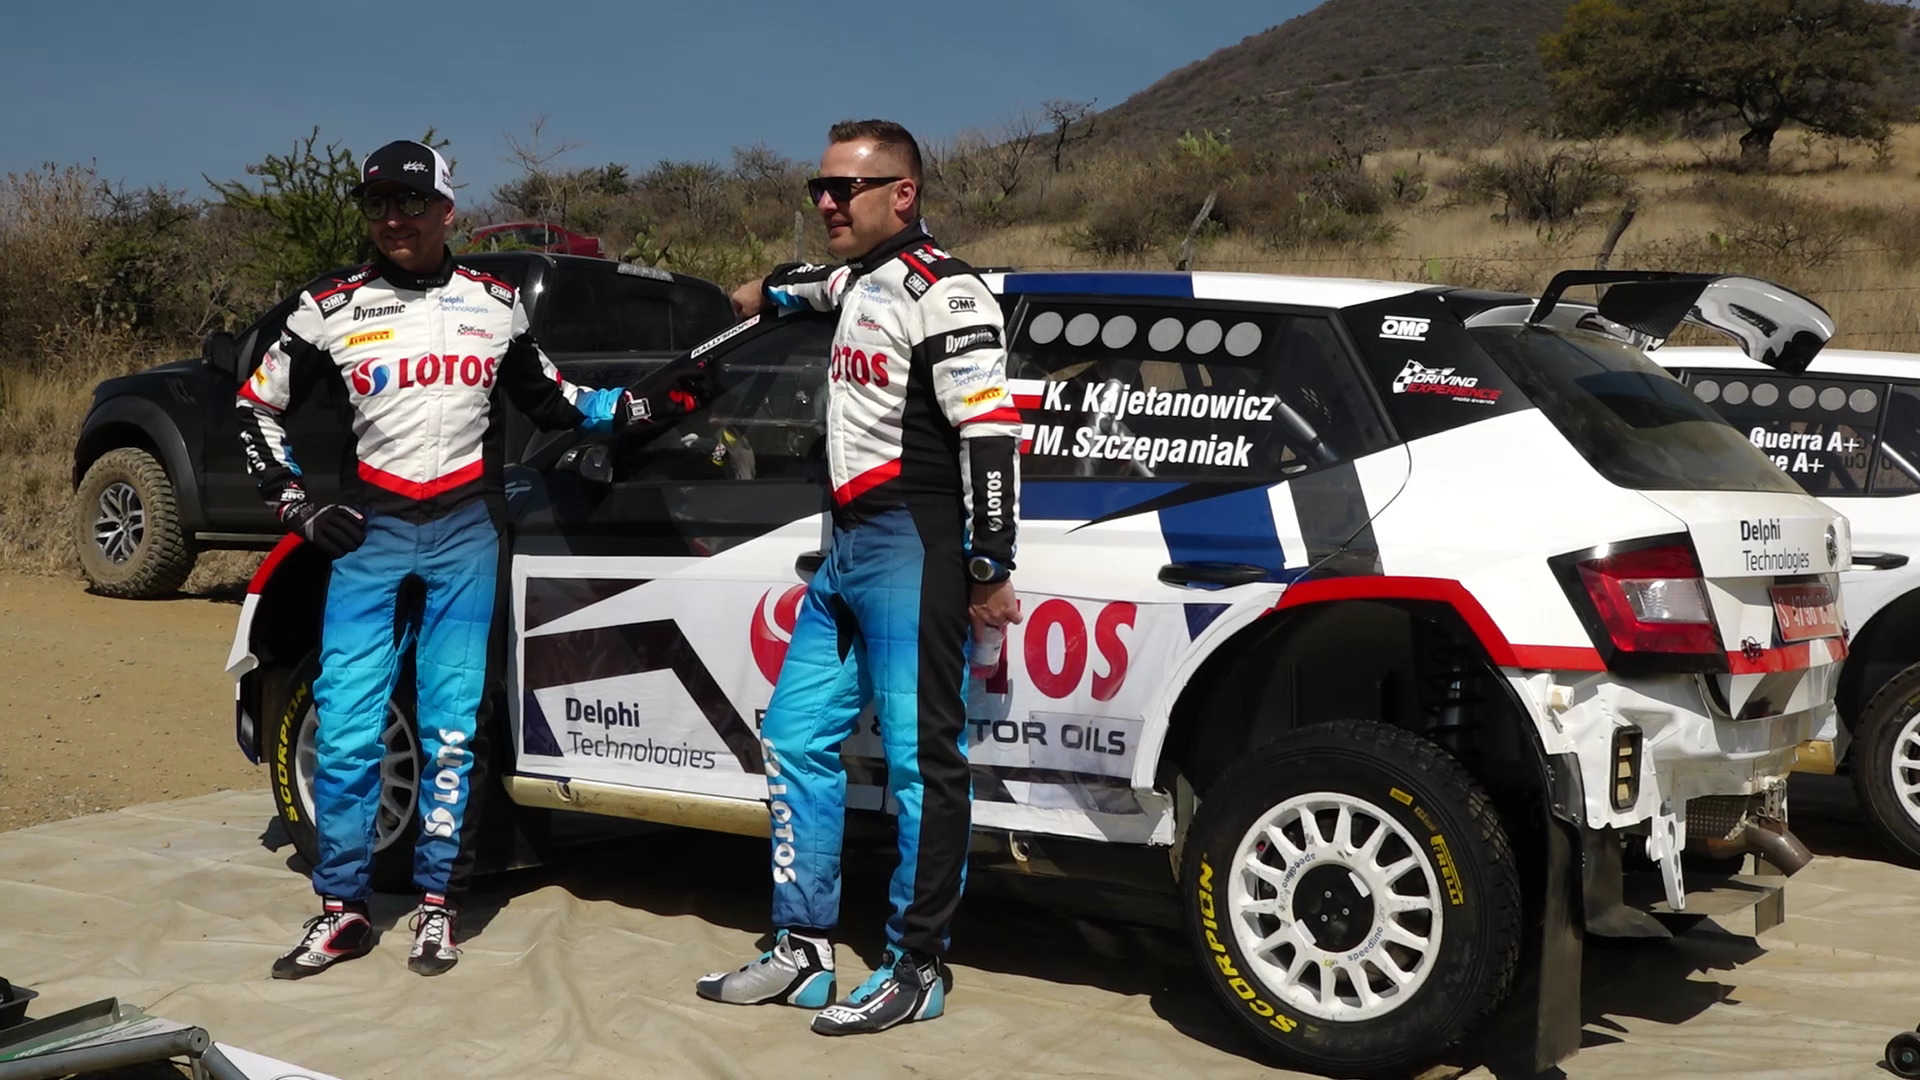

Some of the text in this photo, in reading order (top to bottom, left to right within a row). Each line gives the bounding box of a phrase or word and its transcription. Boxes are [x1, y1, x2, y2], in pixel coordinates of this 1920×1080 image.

[491, 286, 512, 299] OMP
[908, 276, 926, 292] OMP
[322, 293, 346, 309] OMP
[353, 302, 406, 321] Dynamic
[949, 300, 976, 310] OMP
[1381, 319, 1429, 337] OMP
[398, 353, 495, 389] LOTOS
[831, 344, 889, 387] OTOS
[951, 363, 979, 379] Delphi
[1413, 373, 1478, 387] DRIVING
[1044, 381, 1276, 421] K. Kajetanowicz
[1408, 383, 1503, 400] EXPERIENCE
[1750, 427, 1823, 451] Guerra
[1827, 431, 1860, 453] A+
[1792, 452, 1825, 473] A+
[987, 471, 1002, 517] LOTOS
[1740, 518, 1781, 543] Delphi
[1742, 550, 1810, 573] Technologies
[566, 698, 640, 729] Delphi
[277, 682, 307, 822] SCORPION
[567, 731, 716, 769] Technologies
[770, 784, 796, 884] LOTOS
[1199, 861, 1297, 1033] SCORPION
[308, 953, 327, 964] OMP
[795, 949, 808, 968] OMP
[822, 1008, 860, 1023] OMP
